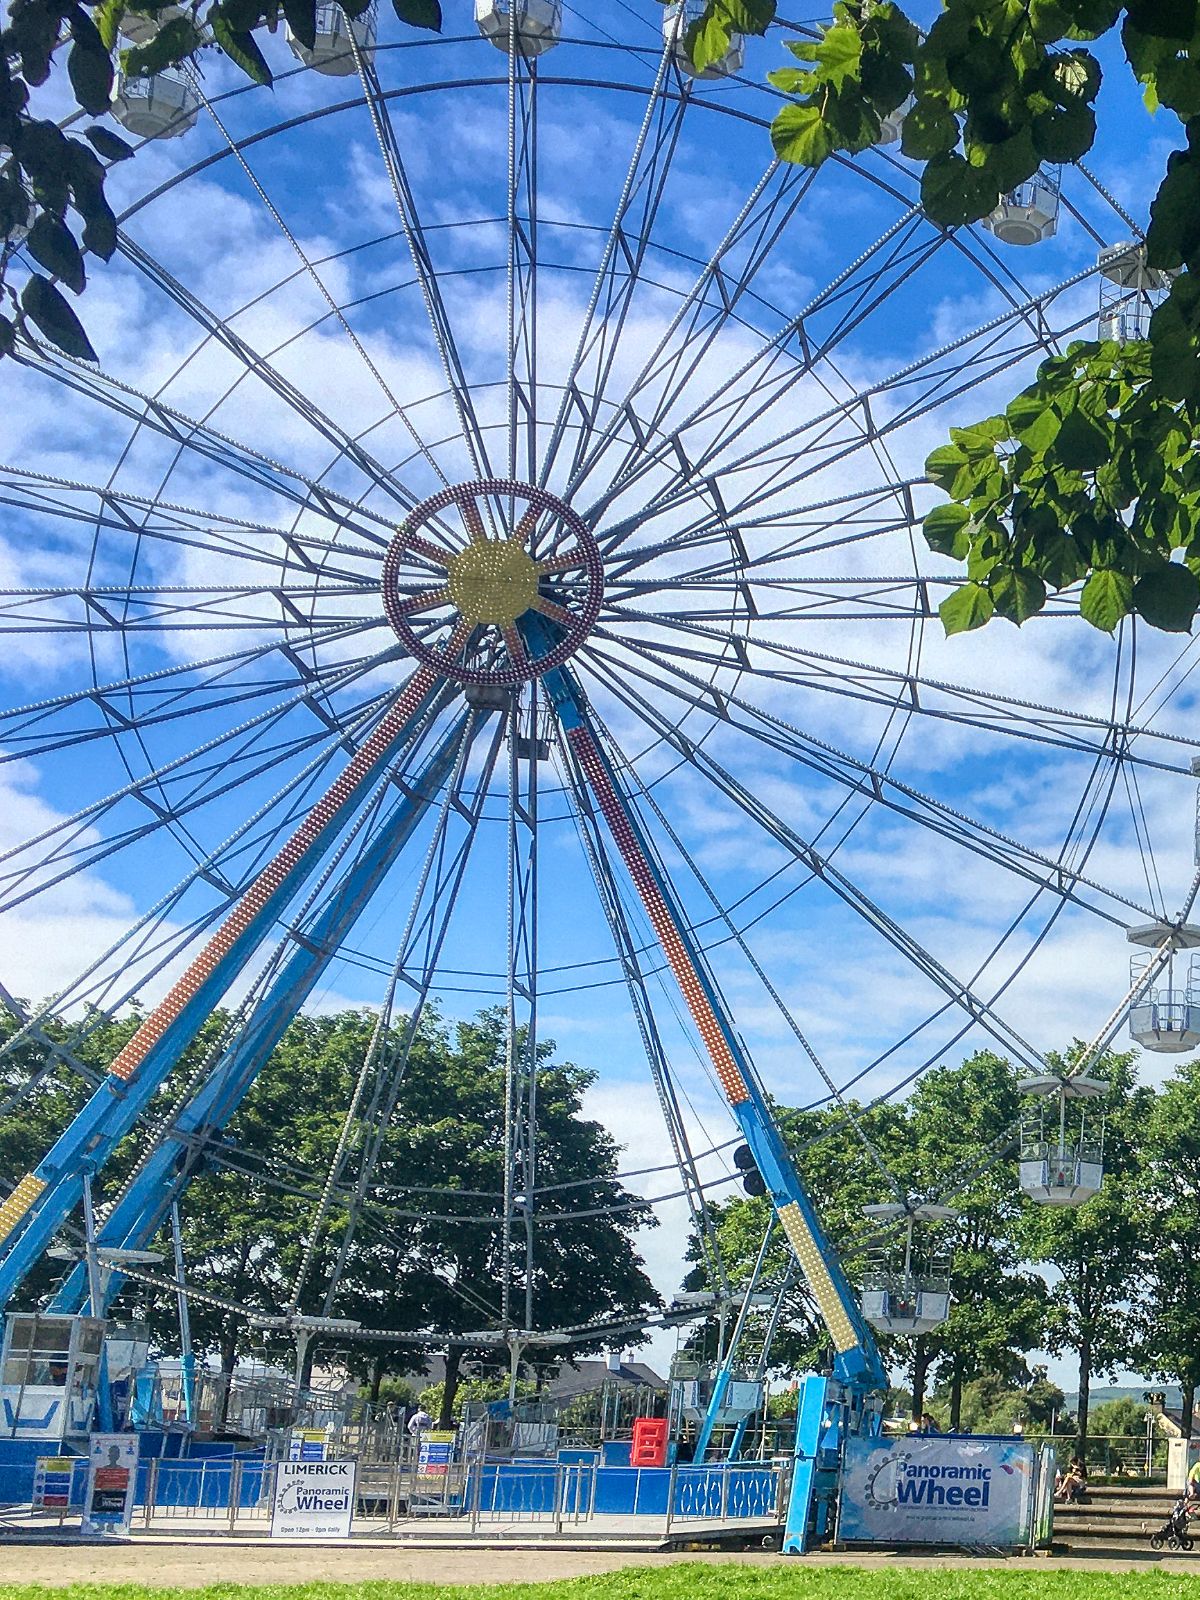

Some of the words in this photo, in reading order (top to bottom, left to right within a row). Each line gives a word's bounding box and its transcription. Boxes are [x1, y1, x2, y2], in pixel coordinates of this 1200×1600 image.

[284, 1464, 348, 1475] LIMERICK
[296, 1486, 350, 1496] Panoramic
[896, 1479, 990, 1507] Wheel
[296, 1495, 349, 1510] Wheel
